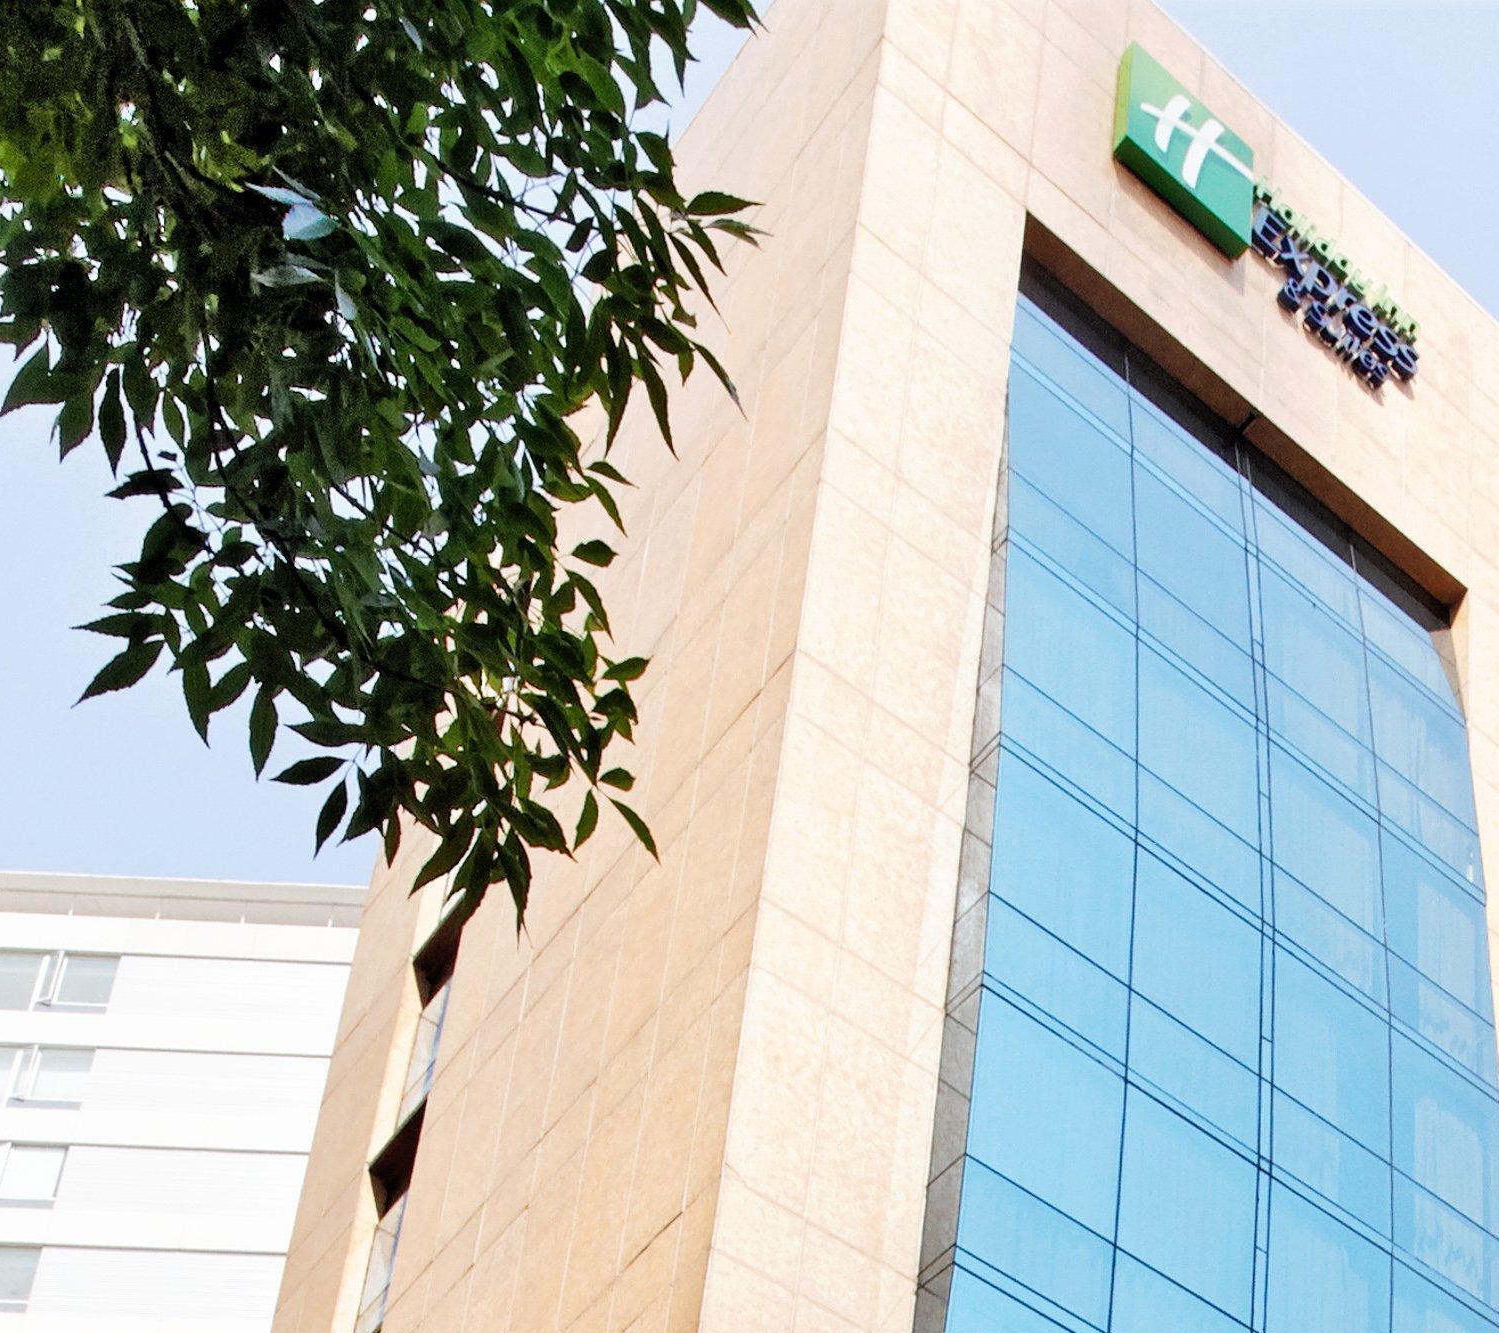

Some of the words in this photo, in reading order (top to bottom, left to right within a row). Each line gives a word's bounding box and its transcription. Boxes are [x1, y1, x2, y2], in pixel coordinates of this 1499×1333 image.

[1251, 204, 1418, 382] Express
[1253, 175, 1373, 298] Holiday
[1368, 283, 1421, 344] Inn
